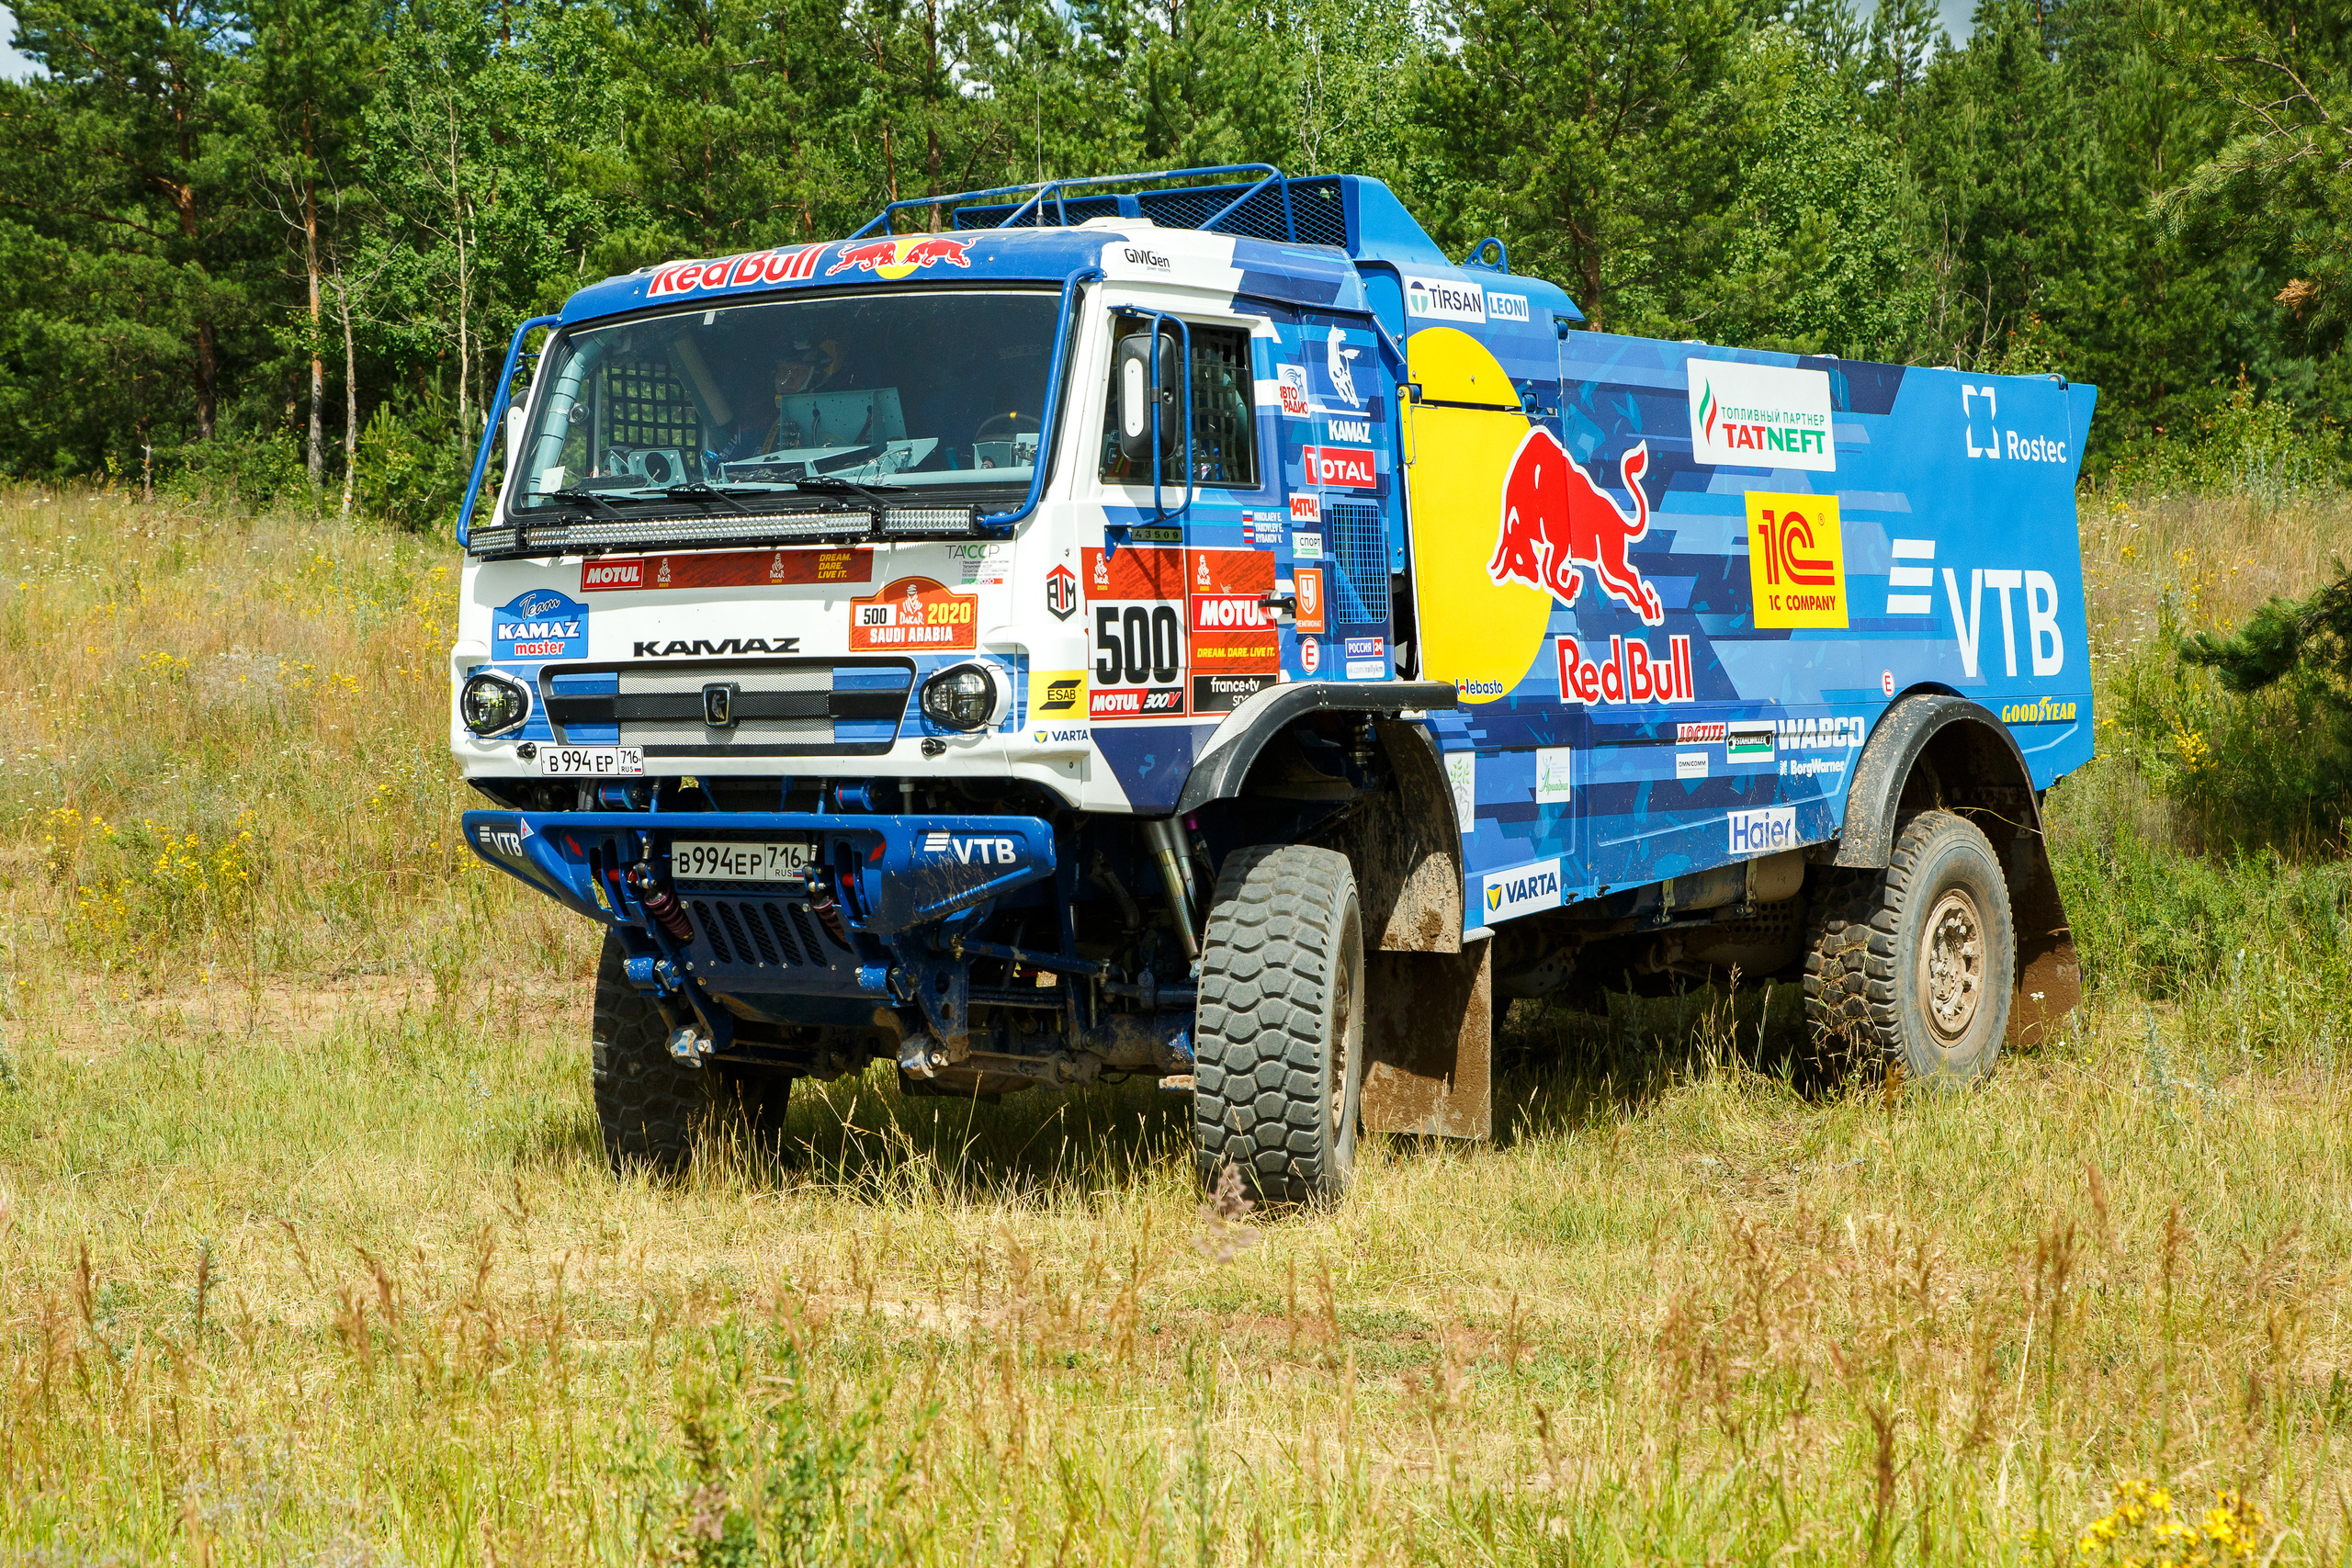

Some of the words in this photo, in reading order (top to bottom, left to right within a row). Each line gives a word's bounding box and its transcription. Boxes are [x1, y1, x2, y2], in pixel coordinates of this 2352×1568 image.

[1489, 297, 1527, 317] LEONI
[1721, 406, 1781, 423] ТОПЛИВНЫЙ
[1783, 412, 1825, 426] ПАРТНЕР
[1328, 419, 1372, 444] KAMAZ
[1722, 423, 1826, 455] TATNEFT
[2007, 430, 2067, 463] Rostec
[1306, 453, 1373, 481] TOTAL
[1299, 537, 1321, 547] СПОРТ
[818, 562, 843, 570] DARE.
[819, 553, 852, 562] DREAM.
[586, 566, 640, 584] MOTUL
[818, 570, 837, 579] LIVE
[837, 570, 847, 579] IT.
[519, 593, 561, 620] Team
[1786, 594, 1836, 611] COMPANY
[863, 607, 888, 625] 500
[927, 602, 971, 625] 2020
[1941, 567, 2064, 678] VTB
[497, 620, 582, 641] KAMAZ
[869, 627, 905, 644] SAUDI
[908, 626, 954, 643] ARABIA
[514, 639, 565, 656] master
[633, 637, 800, 658] KAMAZ
[1096, 606, 1179, 685] 500
[1197, 649, 1227, 658] DREAM.
[1227, 648, 1250, 658] DARE.
[1250, 648, 1265, 657] LIVE
[1266, 647, 1275, 657] IT.
[1306, 645, 1315, 666] E
[1348, 643, 1373, 654] РОССИЯ
[1374, 642, 1383, 652] 24
[1047, 690, 1076, 701] ESAB
[1091, 694, 1140, 712] MOTUL
[1143, 691, 1182, 709] 300V
[1052, 729, 1088, 742] VARTA
[1678, 725, 1724, 742] LOCTITE
[1778, 716, 1865, 750] WABCO
[620, 750, 639, 764] 716
[1791, 759, 1845, 778] BorgWarner
[1733, 812, 1791, 851] Haier
[492, 831, 523, 857] VTB
[952, 838, 1016, 864] VTB
[767, 847, 802, 868] 716
[775, 869, 792, 877] RUS
[1505, 872, 1557, 904] VARTA
